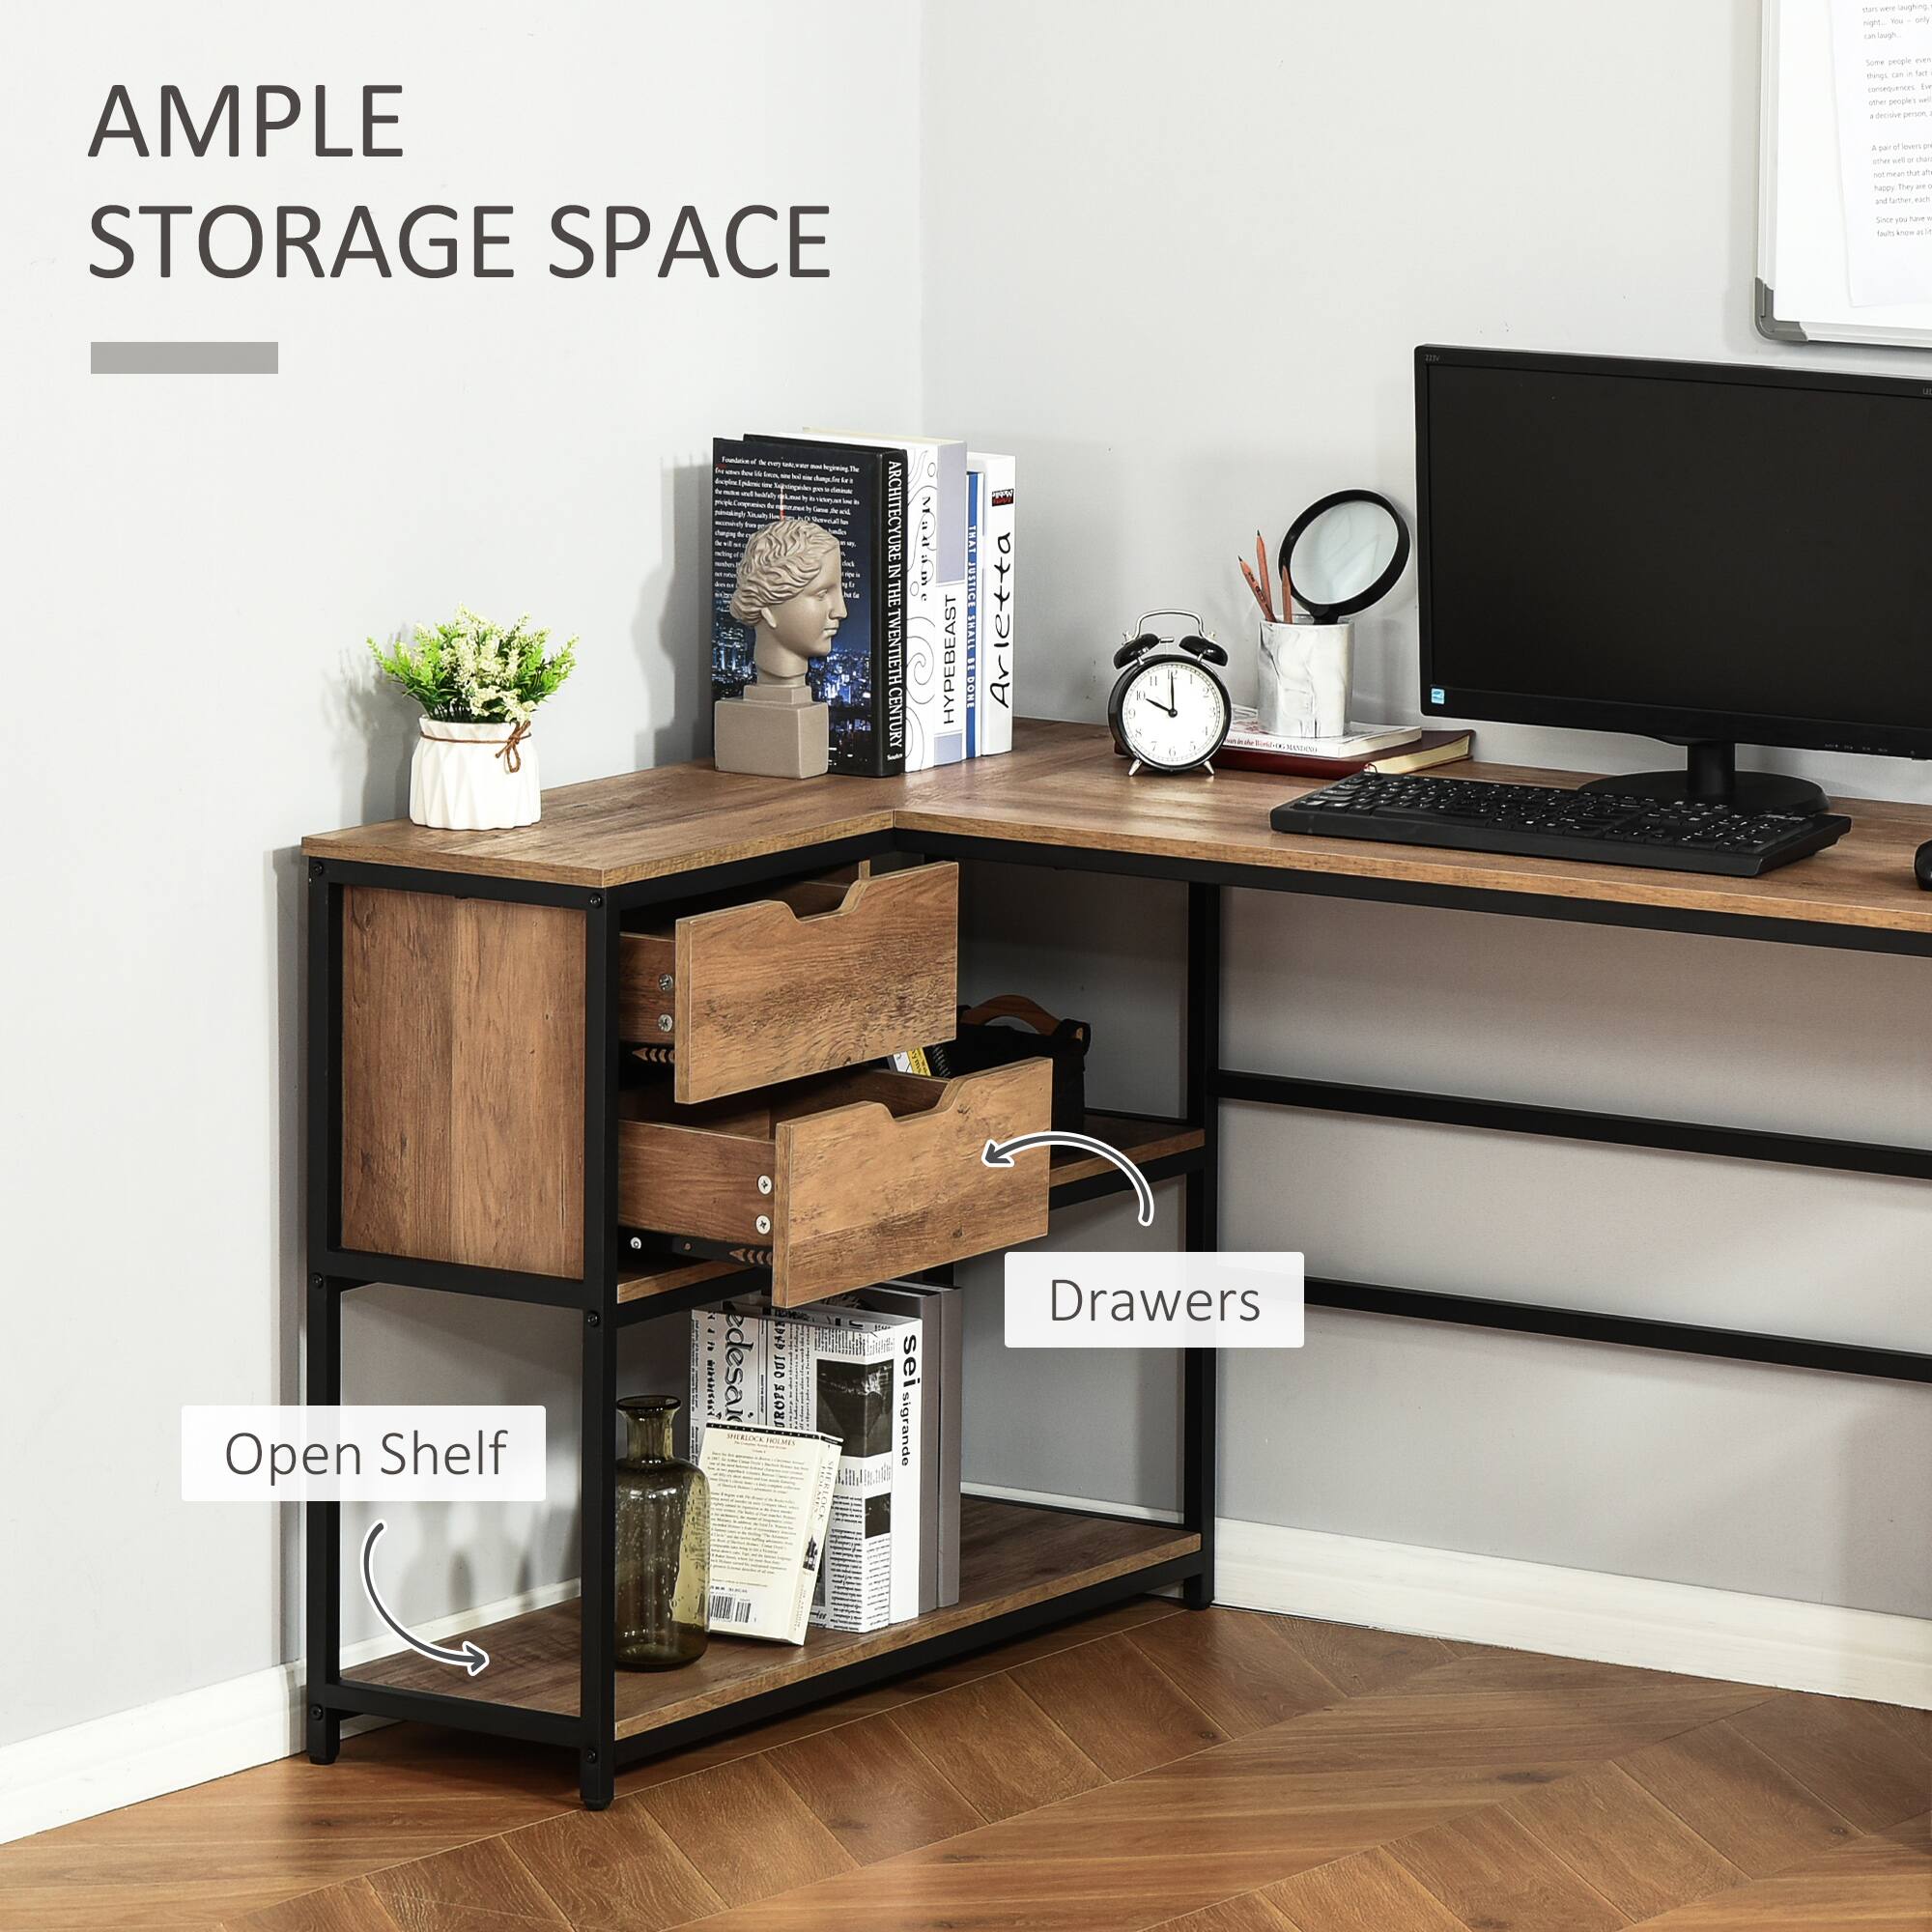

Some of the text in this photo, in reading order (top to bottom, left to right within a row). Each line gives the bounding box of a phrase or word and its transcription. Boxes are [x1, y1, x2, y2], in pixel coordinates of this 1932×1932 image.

[1916, 15, 1930, 24] only
[1902, 142, 1921, 151] lovers
[806, 504, 812, 513] by
[888, 461, 902, 561] ARCHITECYURE
[968, 526, 977, 554] THAT
[922, 497, 931, 601] Madame
[889, 563, 901, 578] IN
[967, 562, 977, 608] JUSTICE
[889, 581, 901, 607] THE
[967, 615, 976, 650] SHALL
[888, 609, 902, 685] TWENTIETH
[944, 594, 956, 724] HYPEBEAST
[967, 658, 975, 670] BE
[1150, 676, 1157, 686] 11
[1167, 669, 1178, 679] 12
[1136, 691, 1146, 700] 10
[1203, 688, 1209, 698] 2
[889, 687, 902, 748] CENTURY
[1128, 708, 1136, 719] 9
[1151, 741, 1157, 752] 7
[1169, 748, 1176, 757] 6
[900, 1334, 921, 1466] sei sigrande
[726, 1433, 796, 1446] SHERLOCK HOLMES
[817, 1460, 835, 1522] SHERLOCK
